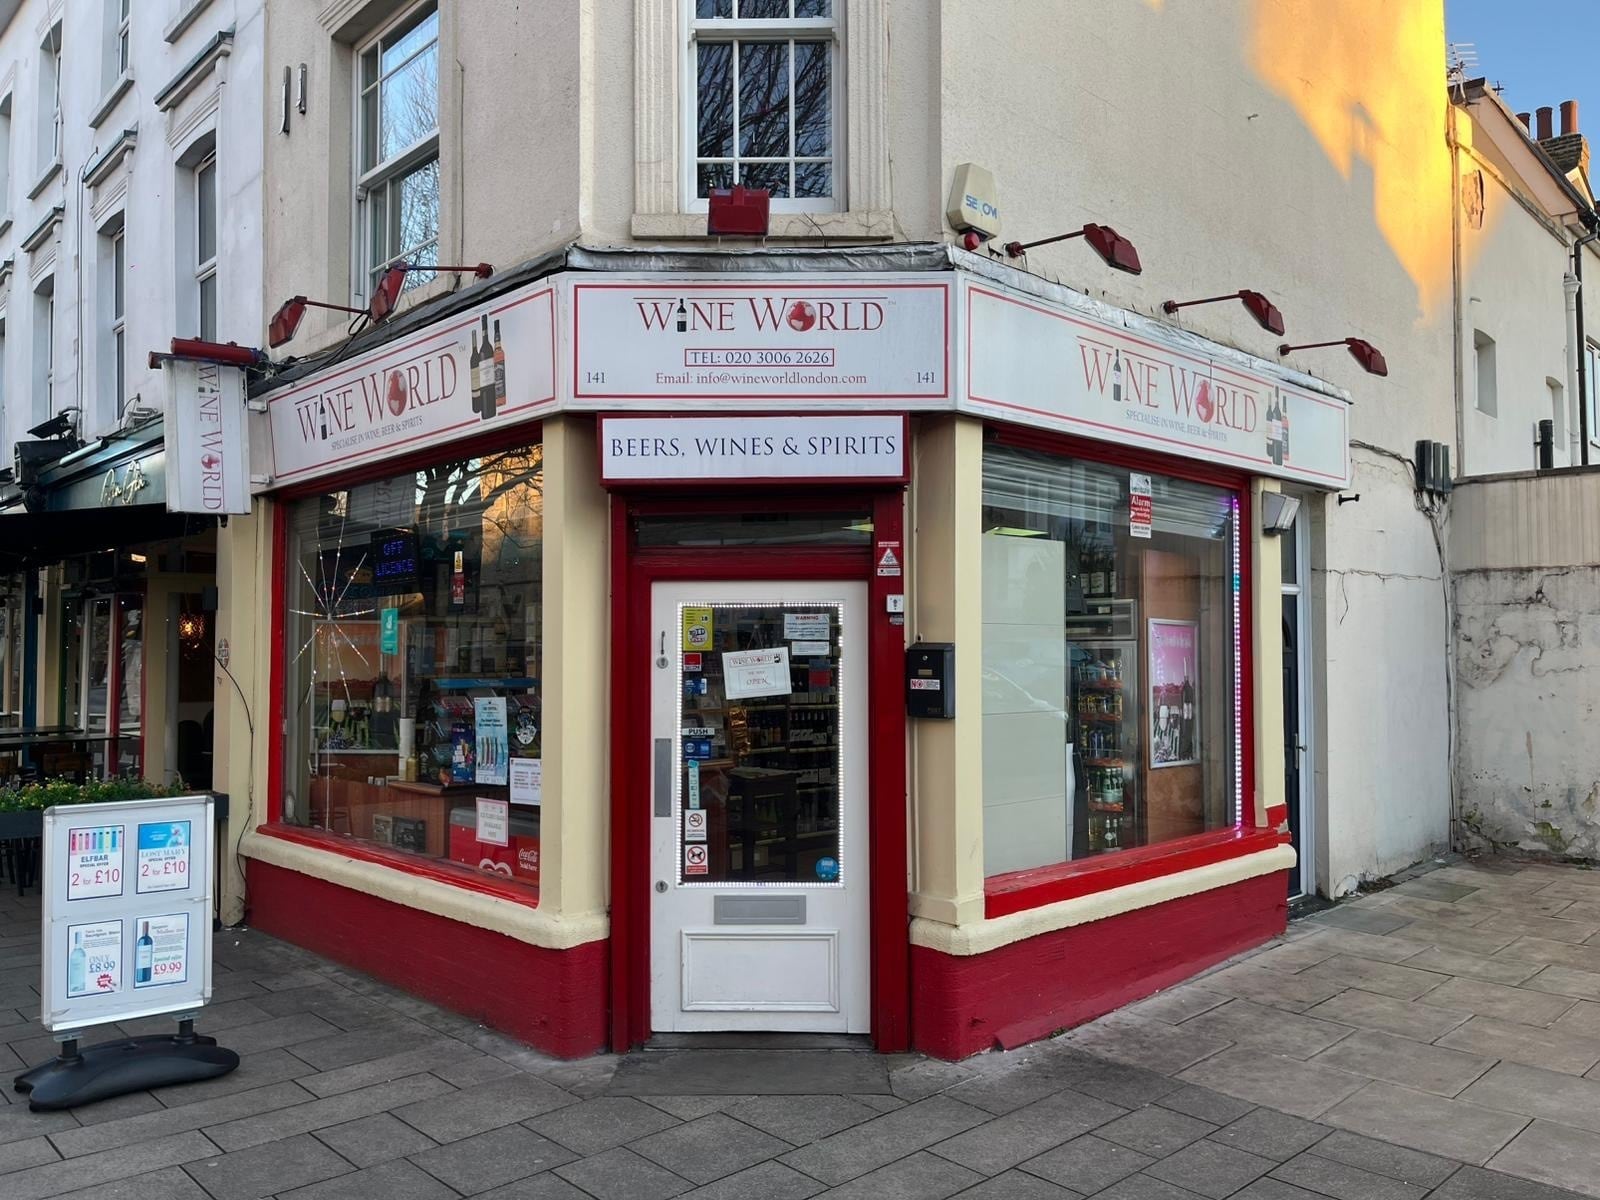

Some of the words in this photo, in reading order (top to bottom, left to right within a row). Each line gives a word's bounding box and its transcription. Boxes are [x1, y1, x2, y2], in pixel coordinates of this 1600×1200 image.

[966, 194, 997, 219] SEOM
[690, 352, 720, 364] TEL:
[725, 352, 752, 364] 020
[757, 352, 791, 364] 3006
[796, 352, 829, 364] 2626
[586, 372, 606, 384] 141
[656, 372, 692, 384] Email:
[697, 372, 867, 384] info@wineworldlondon.com
[917, 372, 935, 384] 141
[611, 438, 685, 457] BEERS,
[695, 437, 774, 456] WINES
[782, 436, 800, 455] &
[807, 435, 895, 455] SPIRITS
[1131, 496, 1151, 507] Alarm
[383, 541, 403, 555] OFF
[81, 854, 109, 863] ELFBAR
[142, 864, 149, 876] 2
[163, 860, 186, 874] £10
[71, 873, 80, 886] 2
[95, 868, 120, 884] £10
[89, 961, 115, 973] £8.99
[154, 961, 182, 975] £9.99
